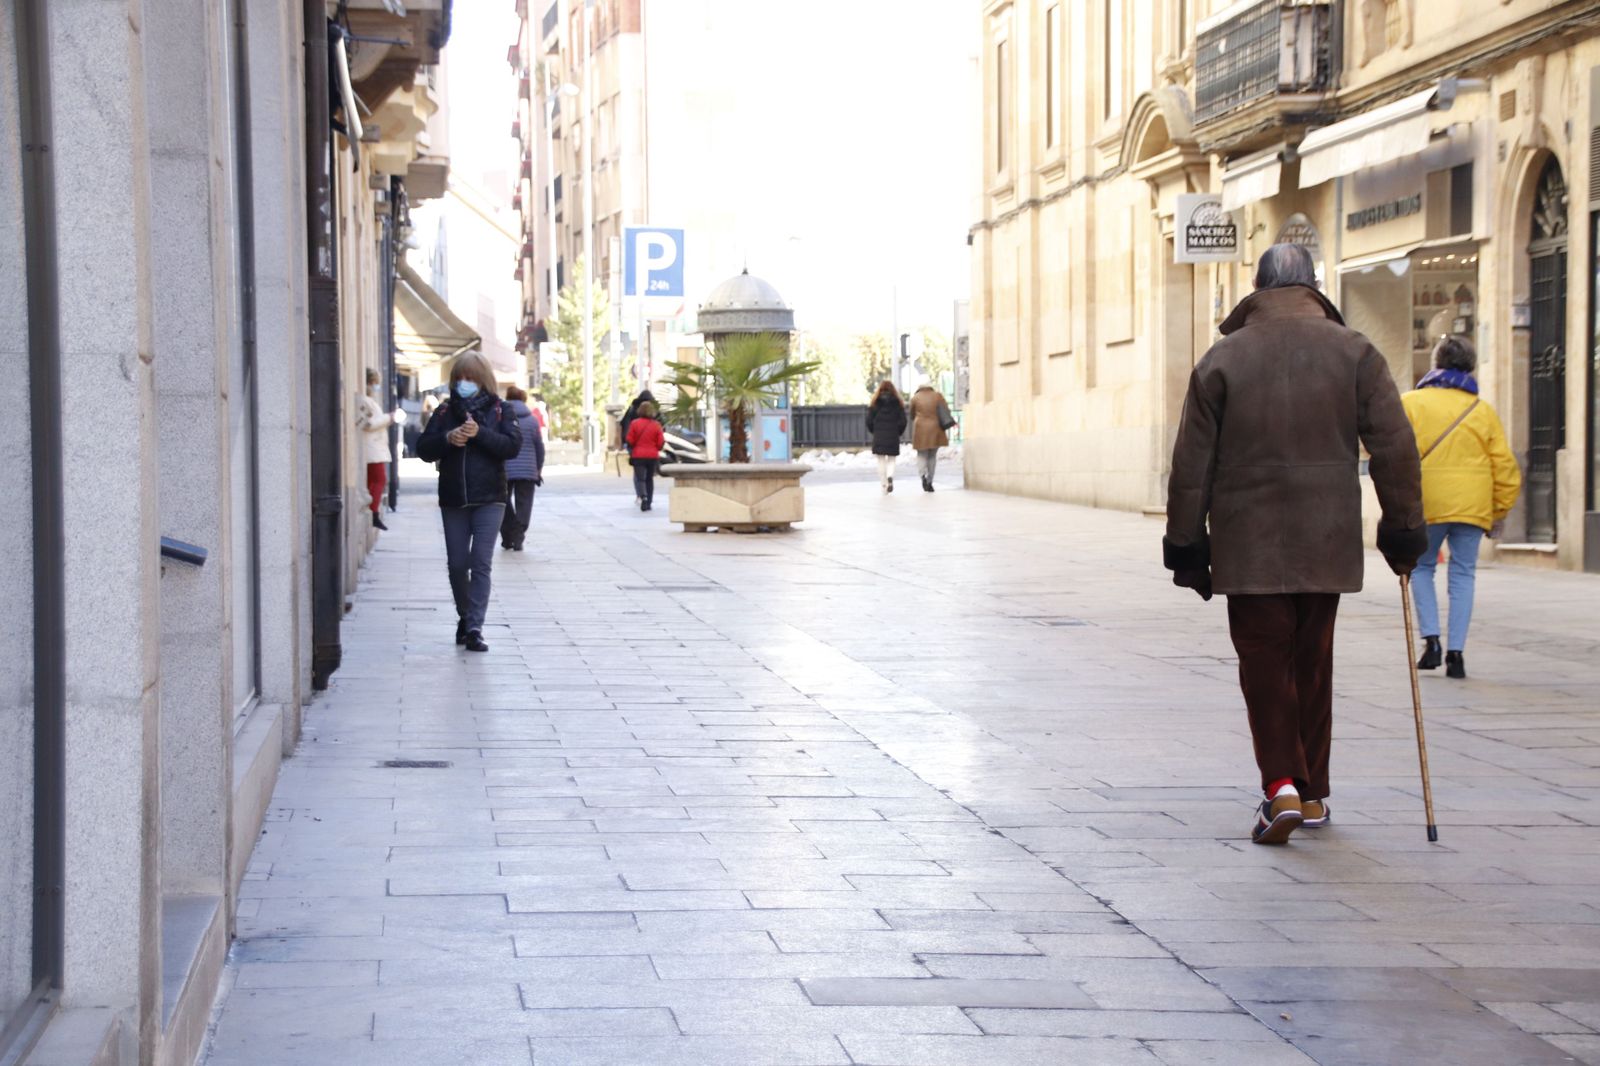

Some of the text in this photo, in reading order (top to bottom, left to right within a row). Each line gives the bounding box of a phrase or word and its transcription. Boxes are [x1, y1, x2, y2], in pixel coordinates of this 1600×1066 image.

[1188, 236, 1235, 246] MARCOS
[635, 232, 677, 295] P
[650, 279, 670, 290] 24h
